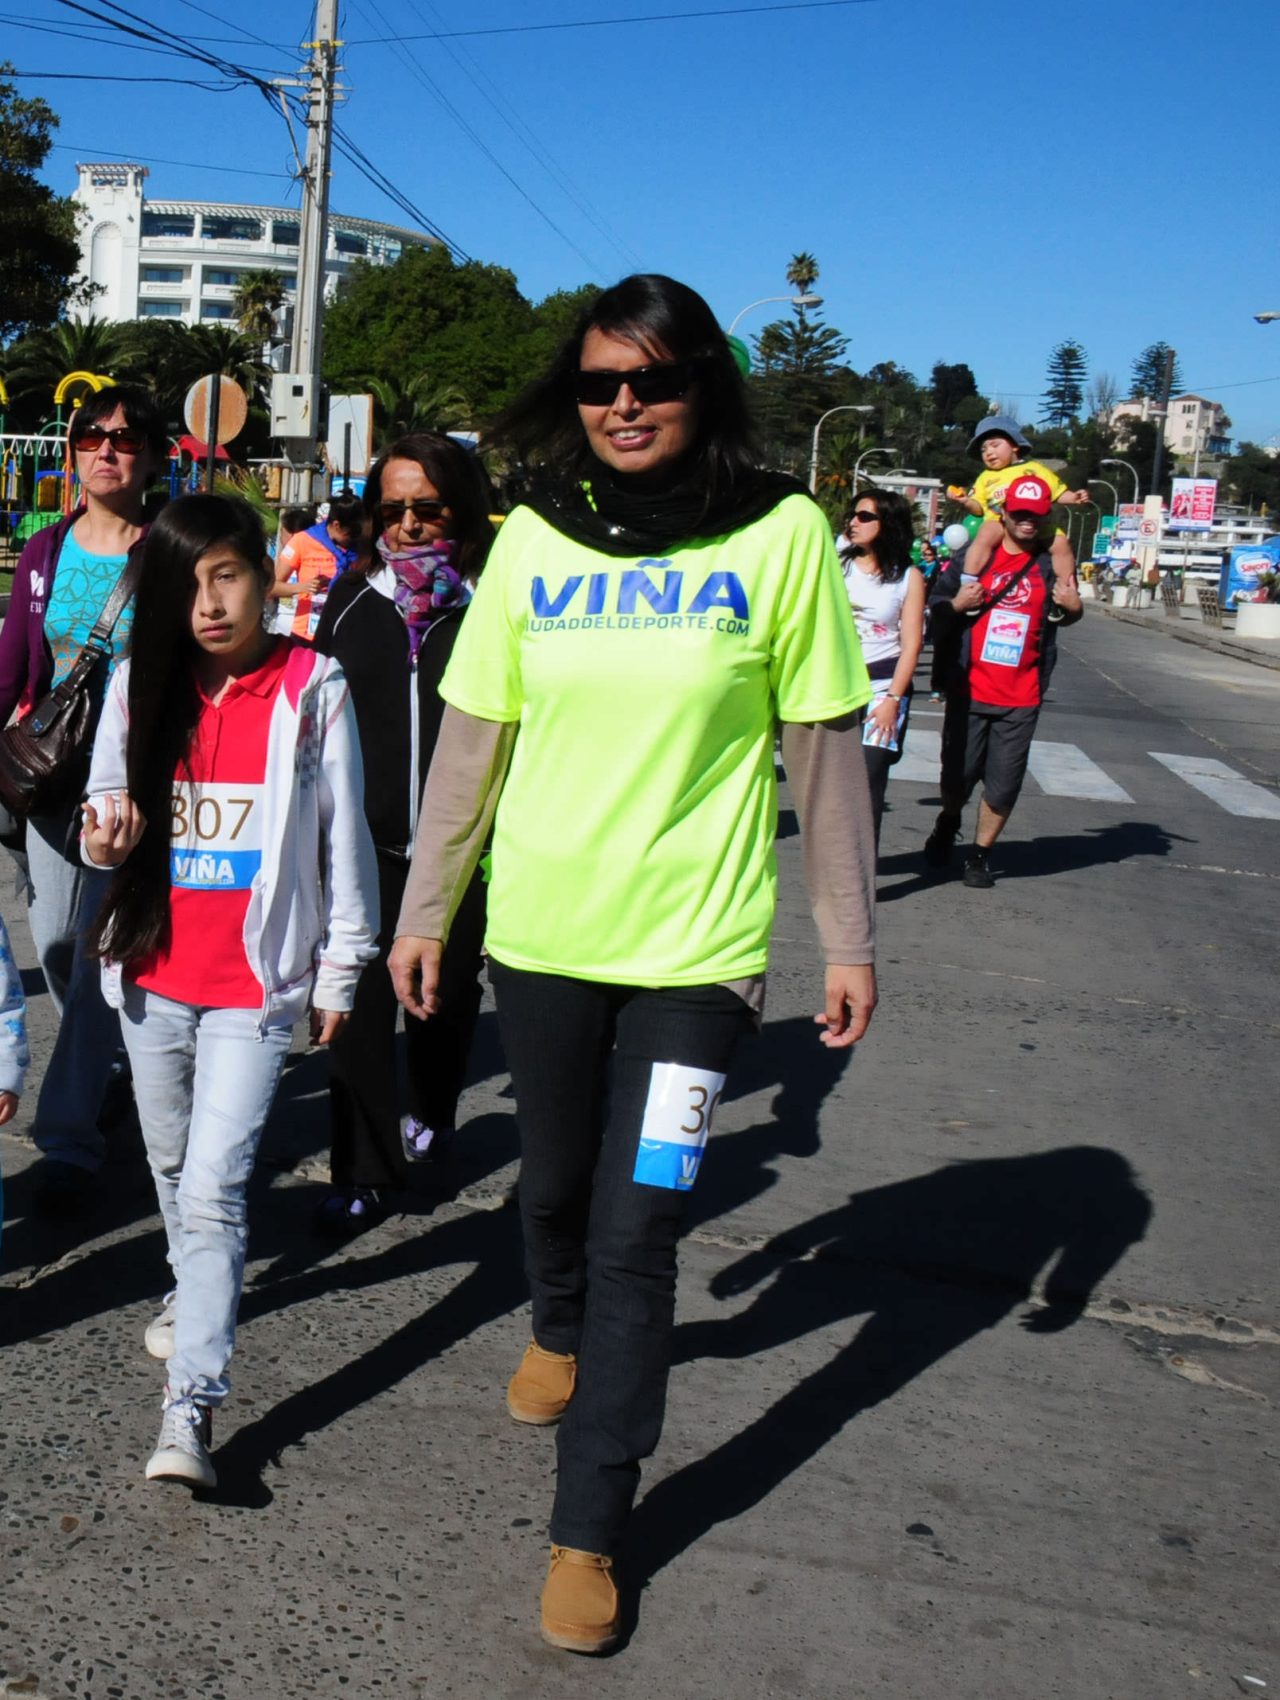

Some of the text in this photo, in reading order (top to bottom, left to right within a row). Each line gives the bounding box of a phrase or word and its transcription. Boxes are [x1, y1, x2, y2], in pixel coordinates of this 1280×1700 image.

[1018, 485, 1038, 497] M
[531, 558, 749, 621] VIÑA
[525, 615, 749, 637] IUDADDELDEPORTE.COM
[986, 644, 1019, 660] VIÑA
[174, 854, 235, 880] VIÑA
